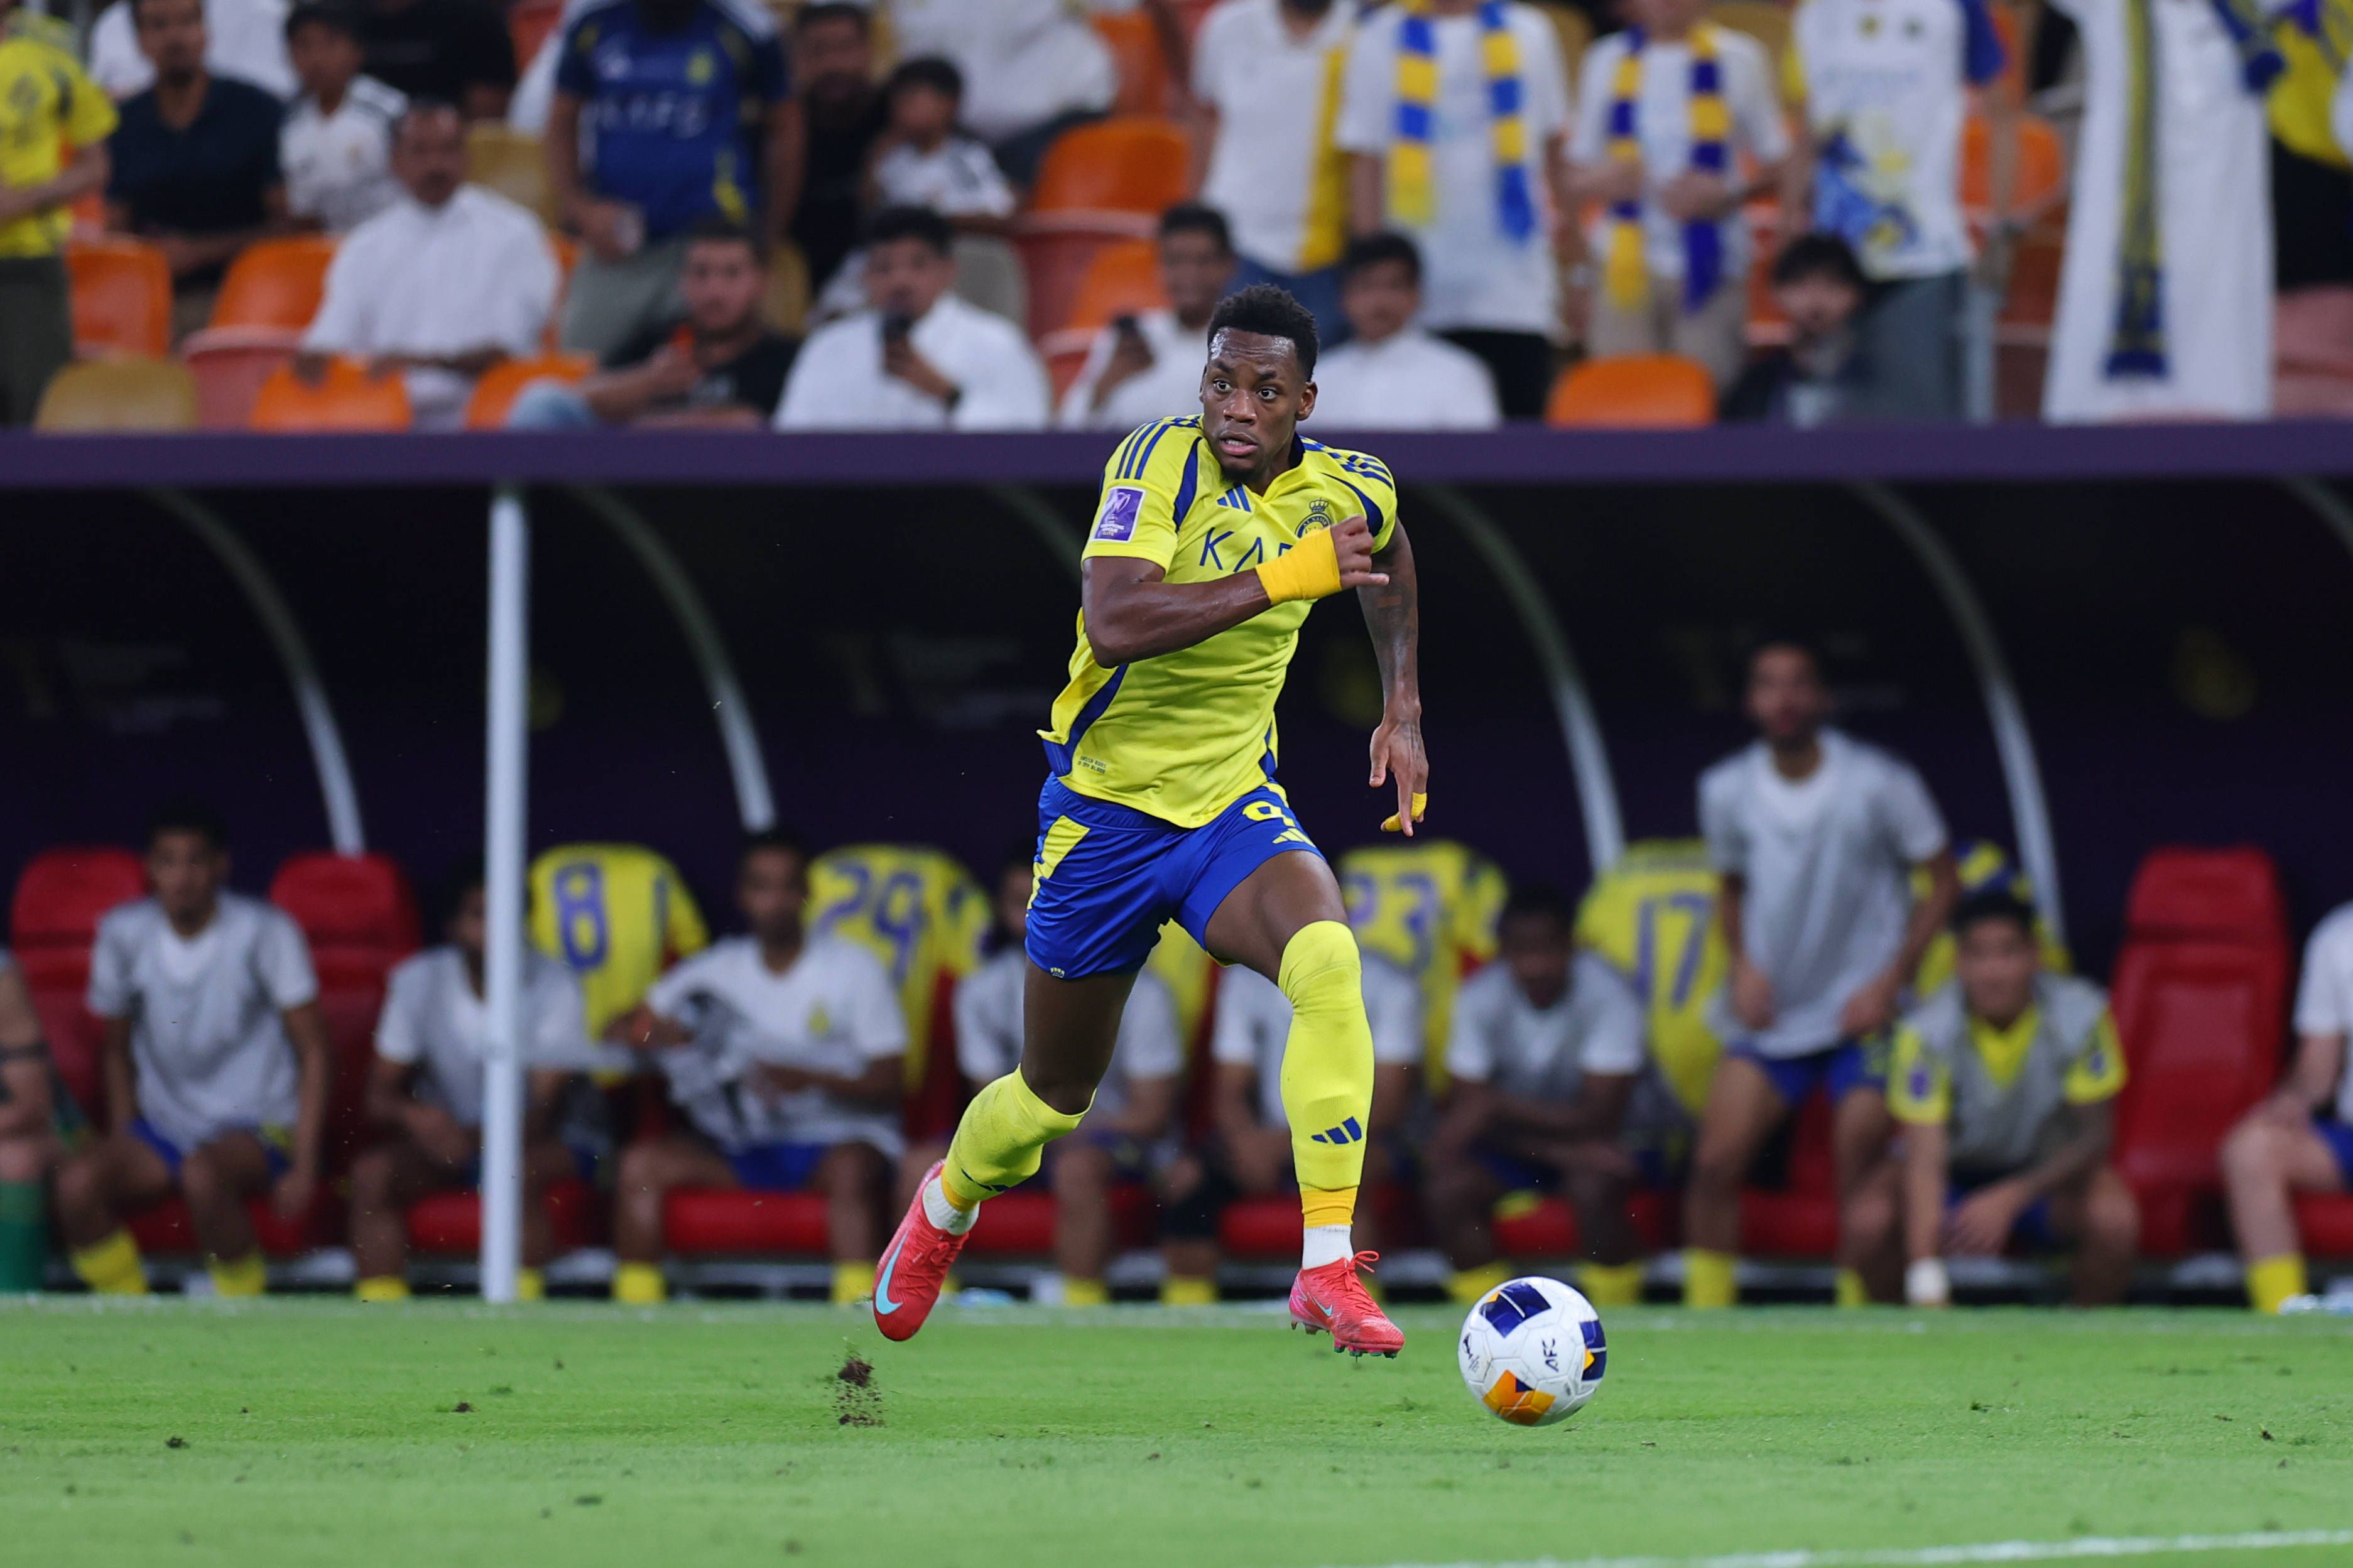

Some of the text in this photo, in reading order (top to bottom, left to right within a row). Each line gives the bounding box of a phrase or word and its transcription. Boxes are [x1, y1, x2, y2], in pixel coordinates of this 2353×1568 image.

[1242, 801, 1296, 828] 9
[553, 862, 608, 972] 8
[815, 861, 927, 987] 29
[1633, 889, 1712, 1006] 17
[1542, 1338, 1559, 1373] AFC
